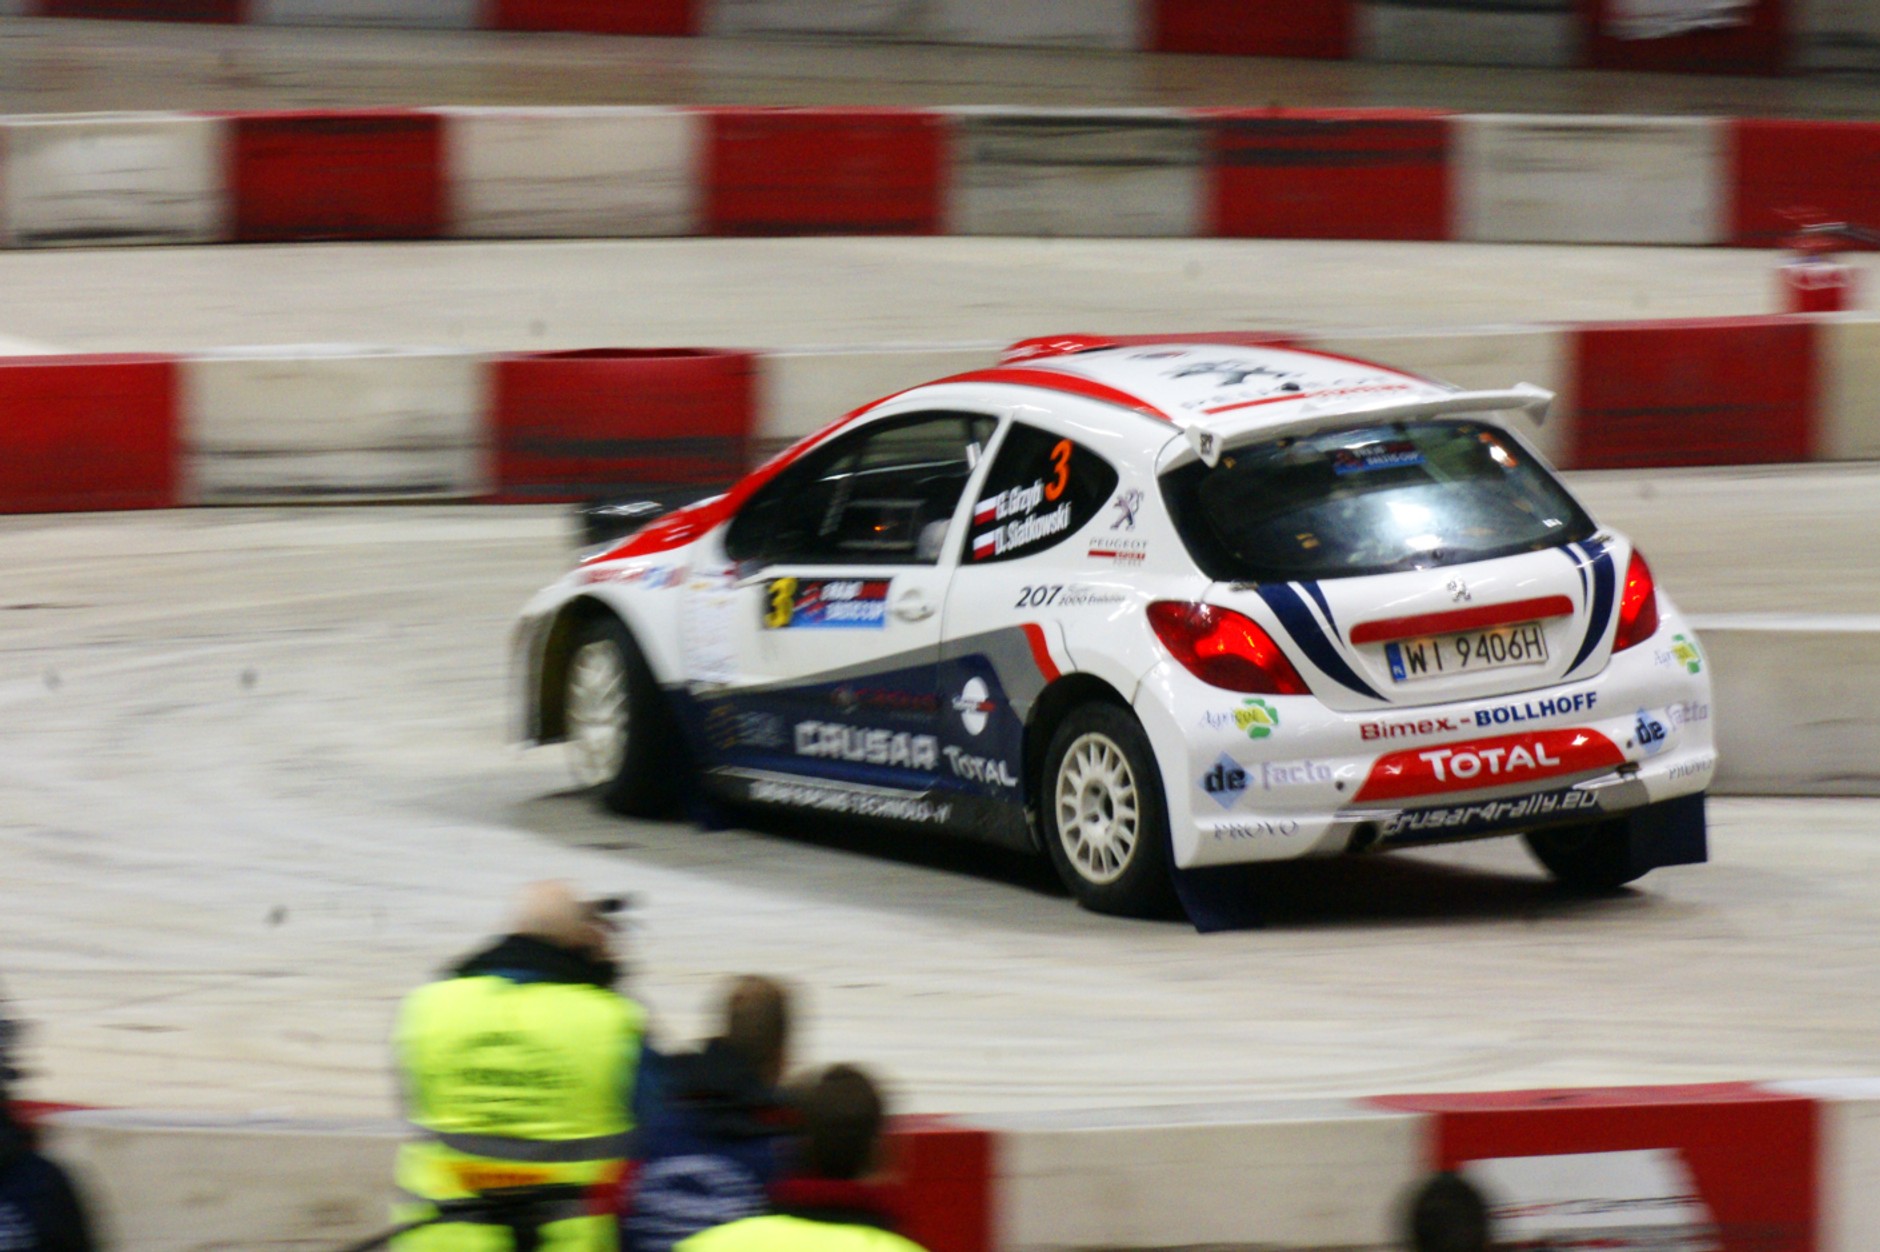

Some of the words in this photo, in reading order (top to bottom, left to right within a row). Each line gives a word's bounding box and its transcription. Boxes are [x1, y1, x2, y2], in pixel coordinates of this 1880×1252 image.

[1045, 438, 1073, 502] 3
[1088, 537, 1148, 549] PEUGEOT
[763, 577, 797, 629] 3
[1014, 585, 1063, 608] 207
[1405, 641, 1444, 674] WI
[1456, 627, 1543, 668] 9406H
[795, 720, 939, 771] CRUSAR
[1635, 717, 1667, 746] de
[942, 745, 1019, 788] TOTAL
[1203, 762, 1247, 793] de
[1261, 760, 1333, 791] facto
[1418, 742, 1561, 782] TOTAL
